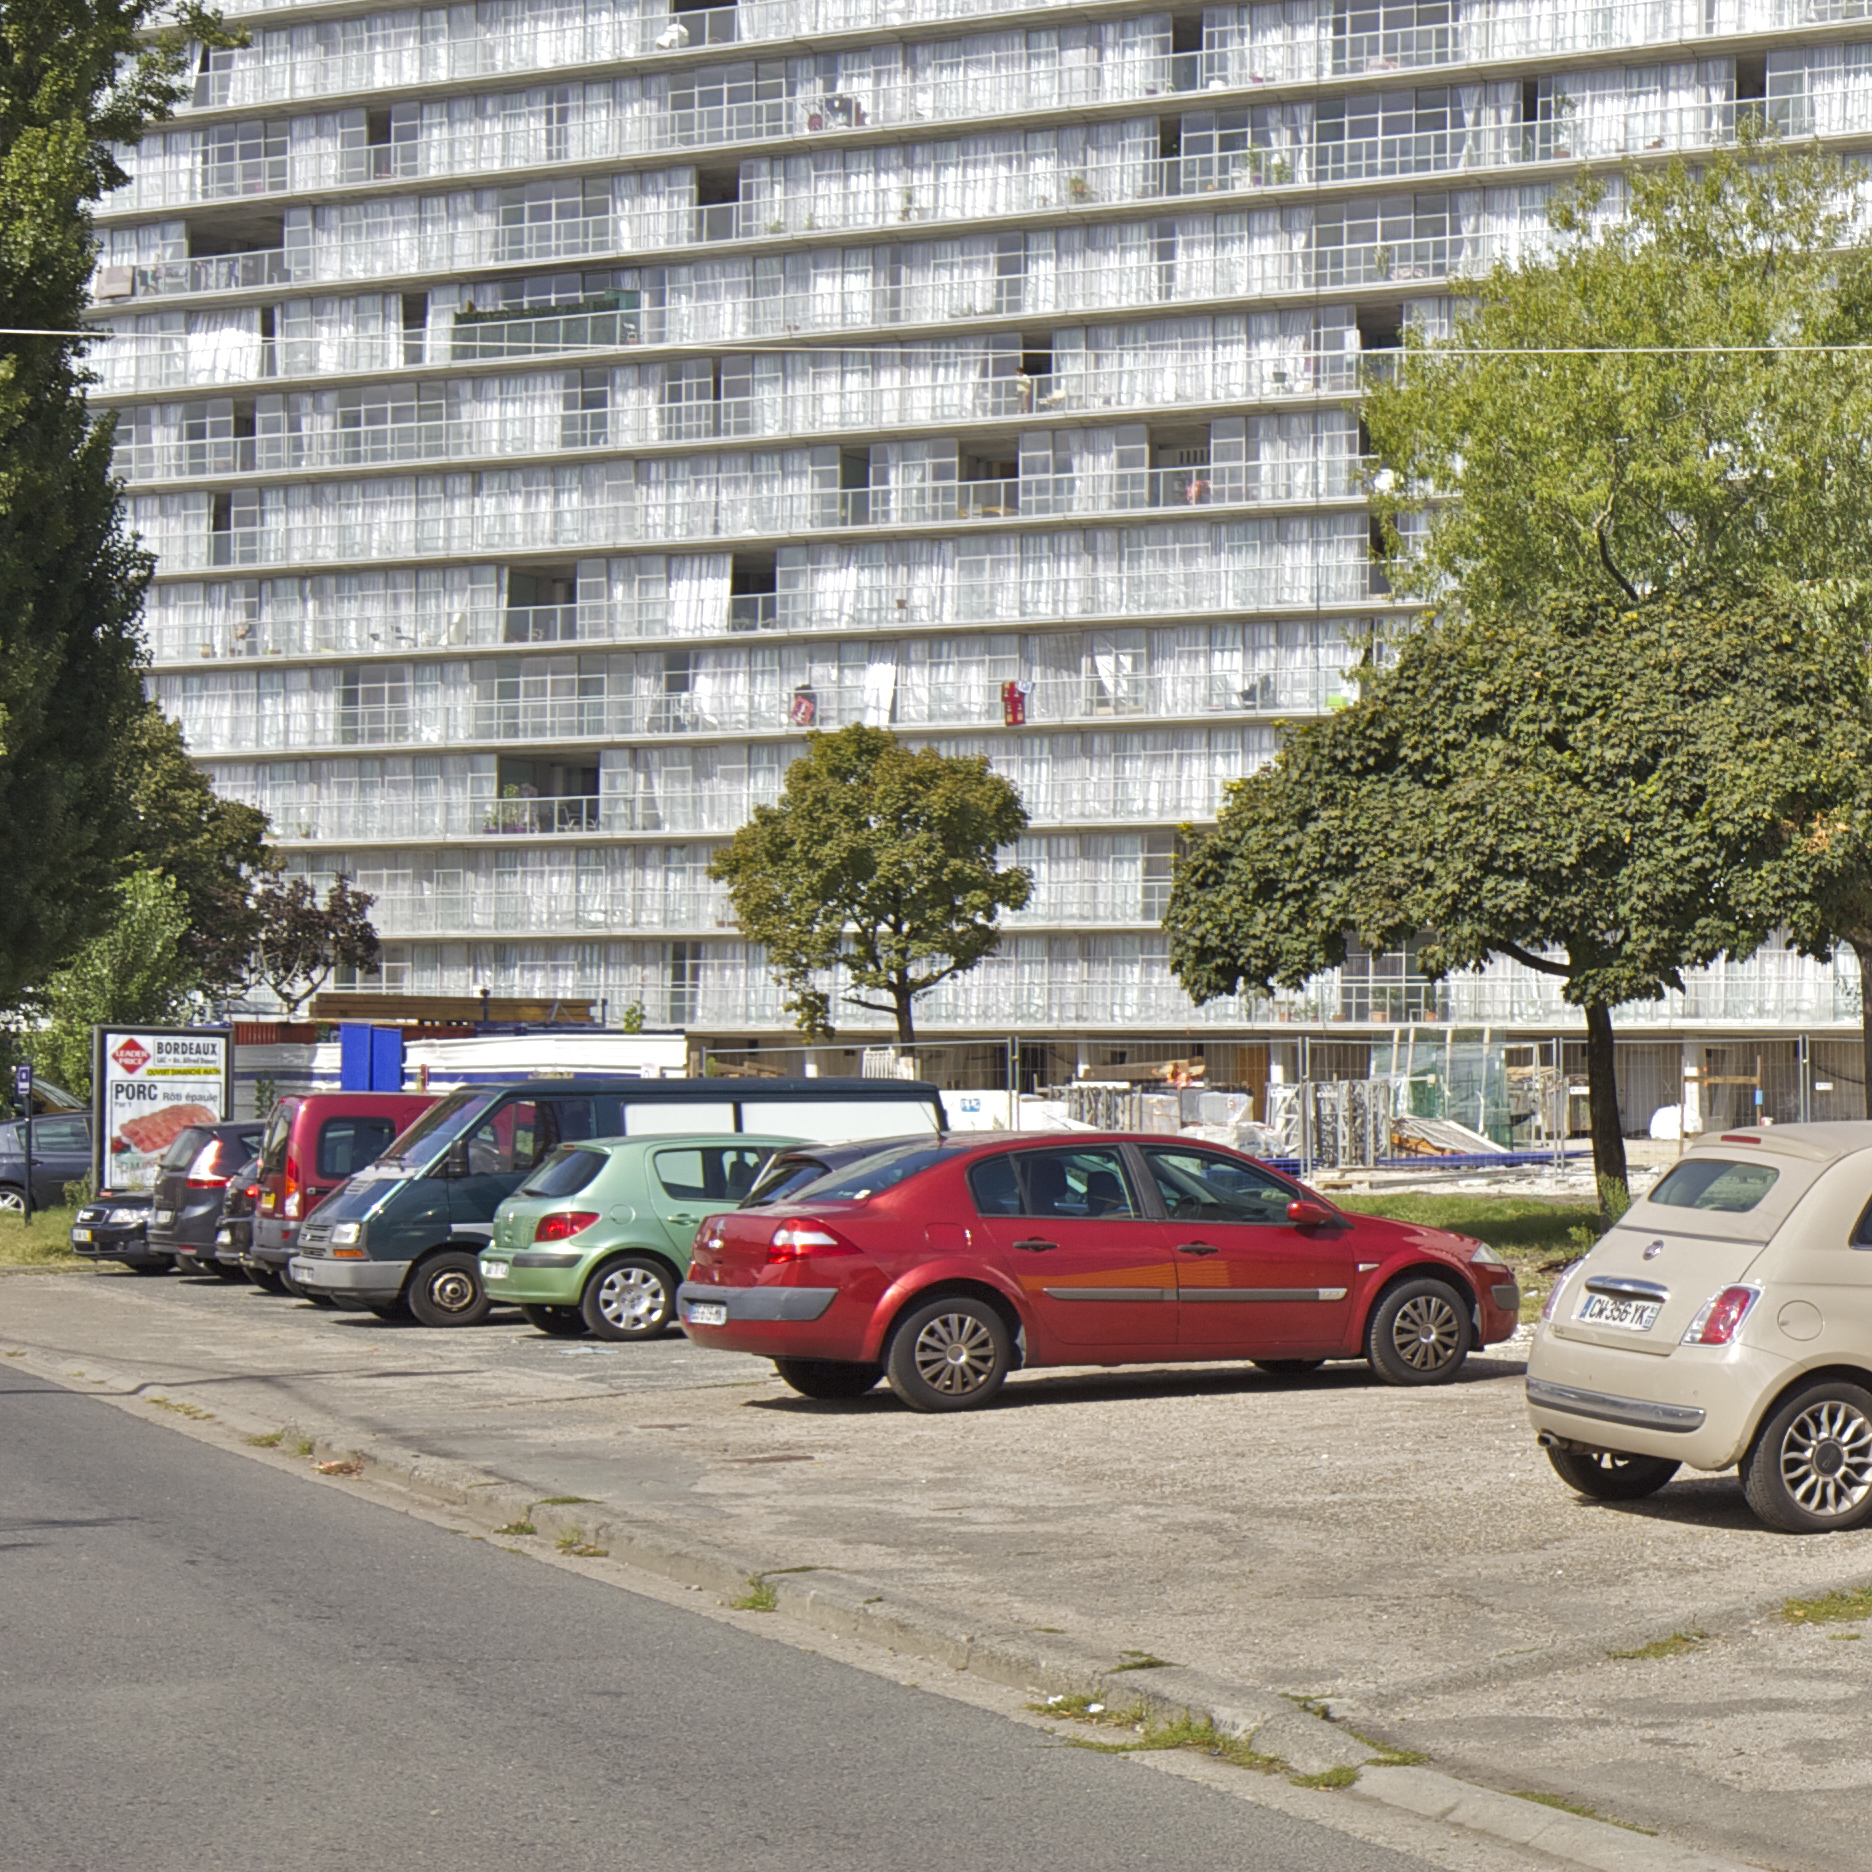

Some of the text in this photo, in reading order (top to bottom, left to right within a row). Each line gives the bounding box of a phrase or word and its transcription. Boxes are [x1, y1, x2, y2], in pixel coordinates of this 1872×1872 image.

[115, 1049, 148, 1058] LEADER
[156, 1041, 217, 1056] BORDEAUX
[118, 1058, 144, 1066] PRICE
[114, 1083, 218, 1104] PORC Rôti épaule
